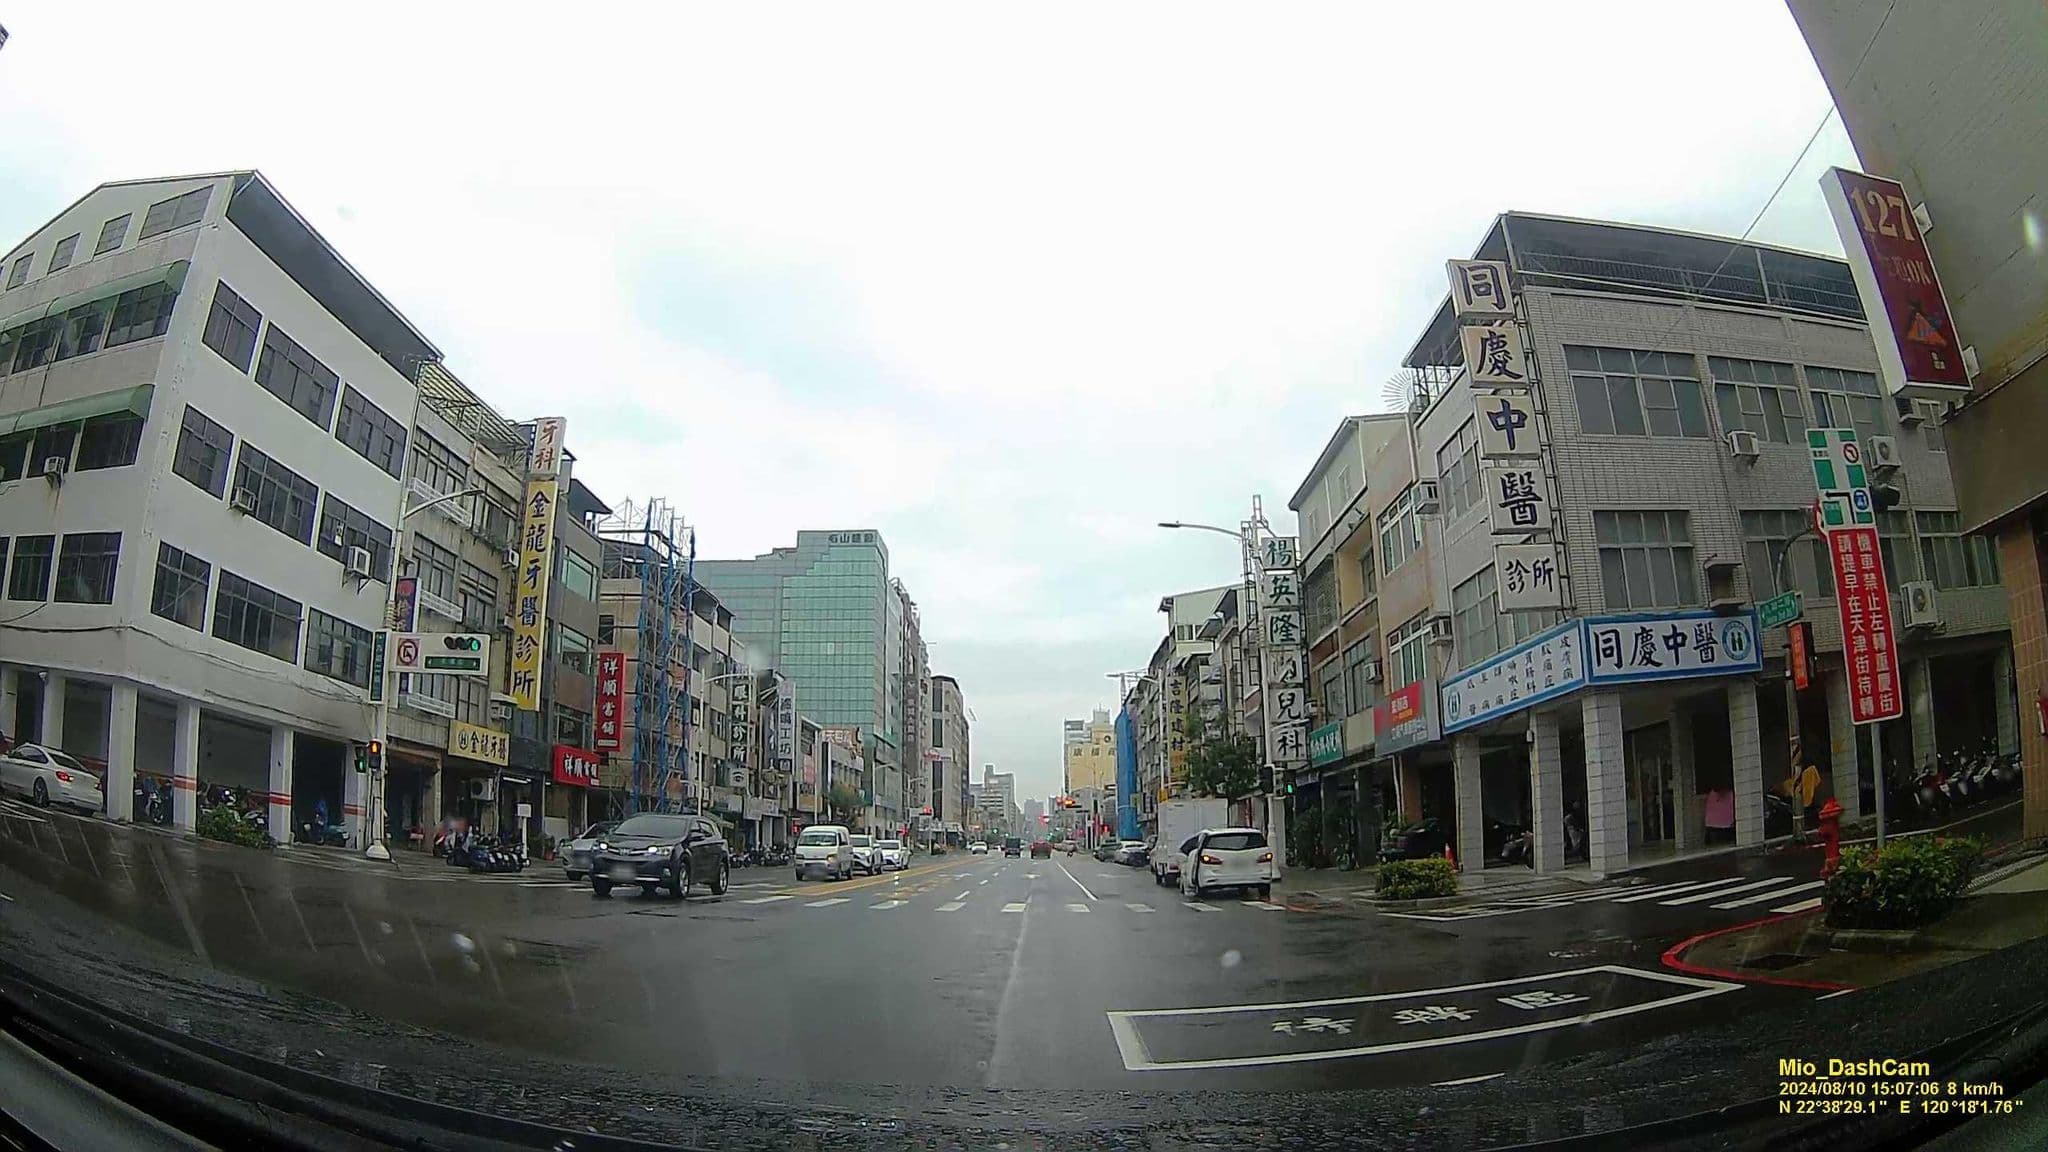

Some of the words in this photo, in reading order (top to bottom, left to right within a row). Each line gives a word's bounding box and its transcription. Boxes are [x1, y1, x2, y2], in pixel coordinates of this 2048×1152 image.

[1852, 186, 1915, 241] 127
[1457, 264, 1543, 526] 同慶中醫
[535, 420, 558, 470] 牙科
[512, 490, 551, 699] 金龍牙醫診所
[1504, 558, 1554, 594] 診所
[1593, 621, 1719, 669] 同慶中醫
